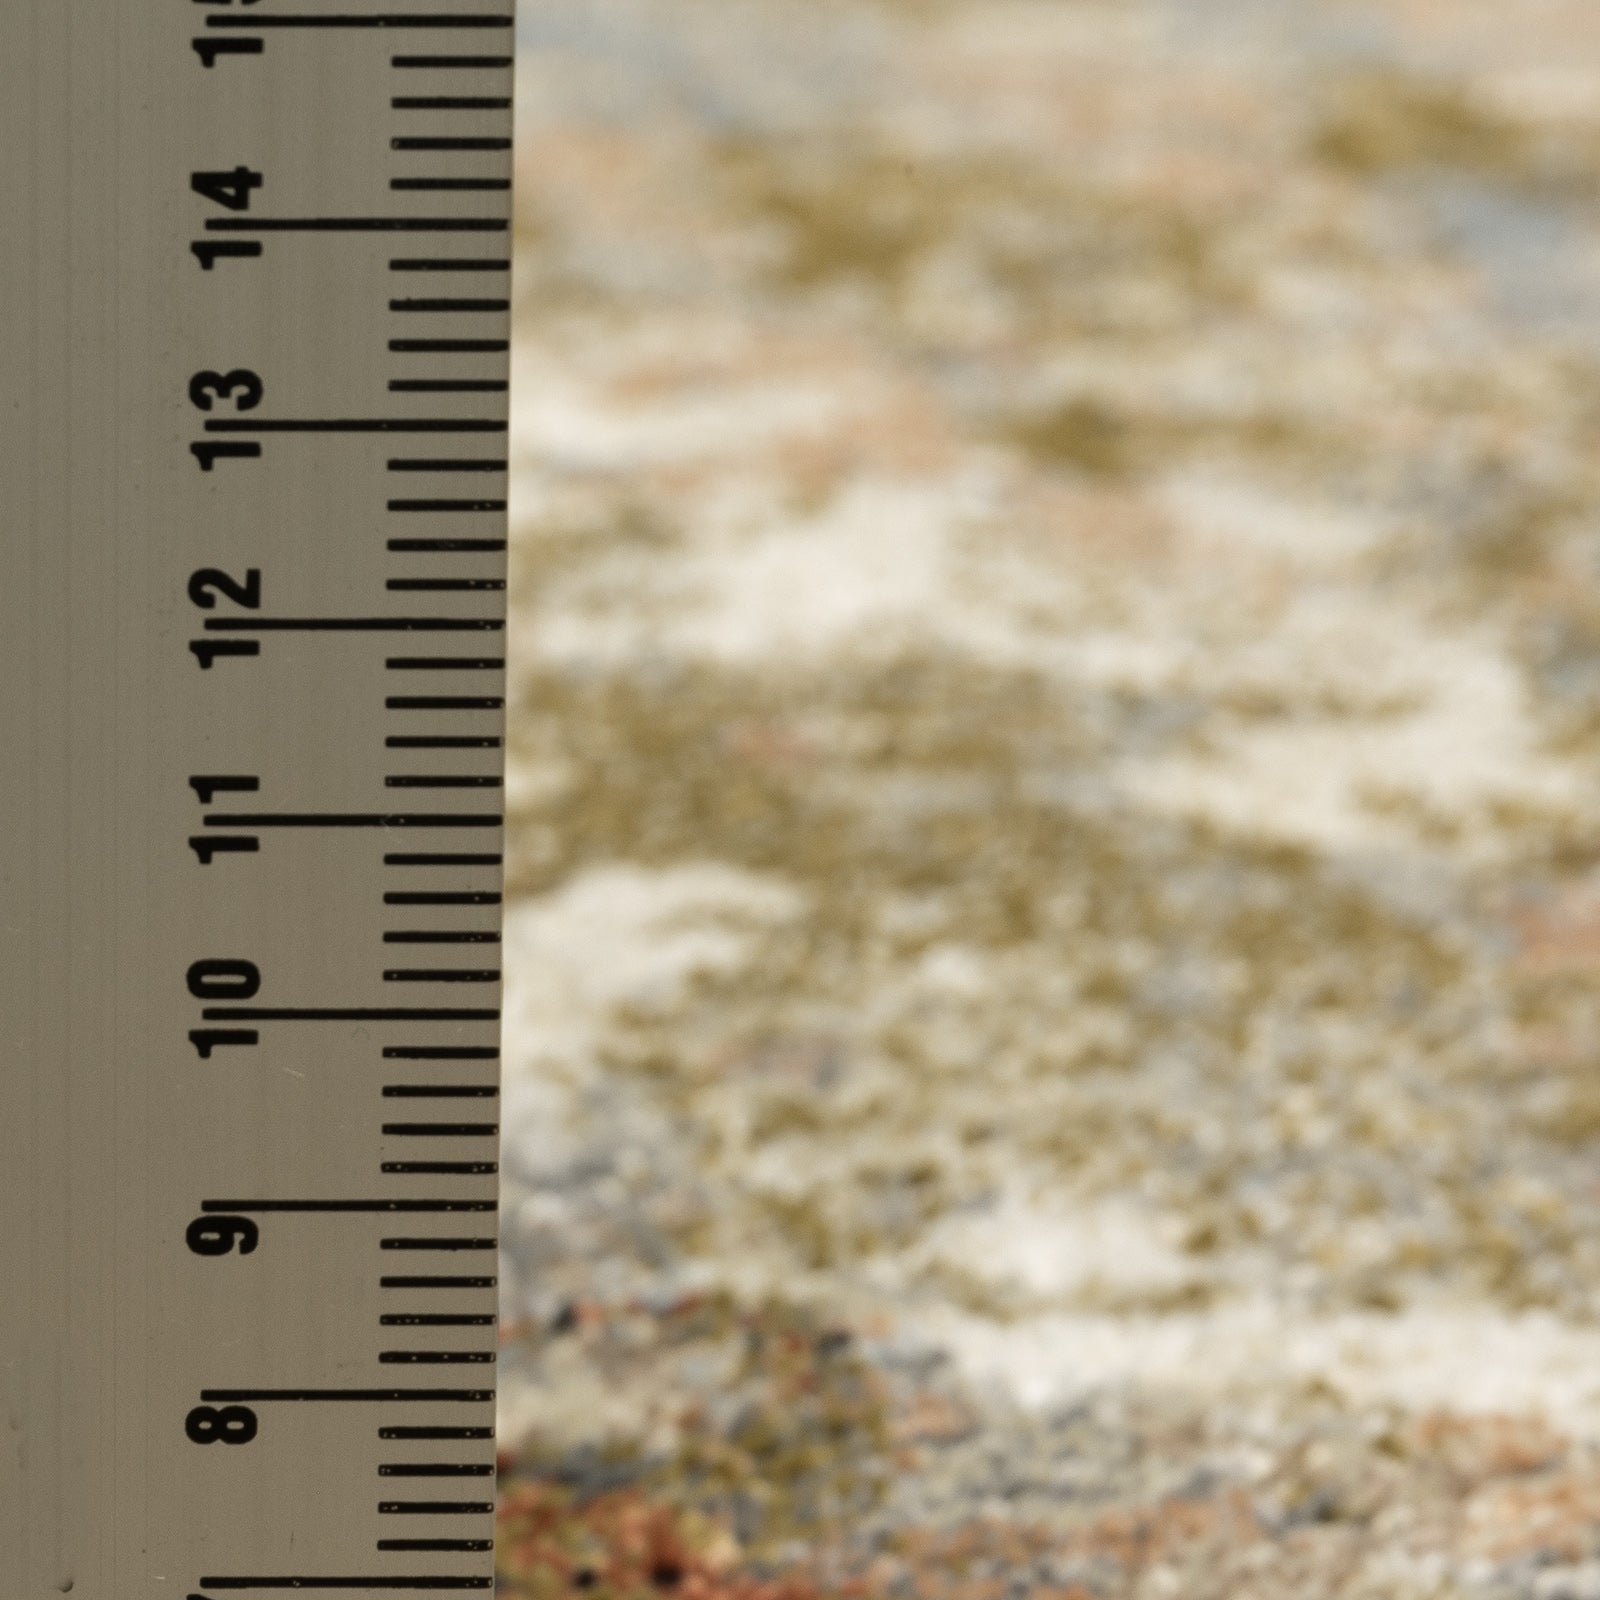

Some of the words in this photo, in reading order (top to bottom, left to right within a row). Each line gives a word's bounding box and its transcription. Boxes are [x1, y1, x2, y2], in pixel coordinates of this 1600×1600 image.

[190, 0, 264, 69] 1
[190, 166, 263, 271] 14
[188, 369, 264, 472] 13
[187, 568, 261, 670] 12
[188, 775, 260, 865] 11
[185, 958, 261, 1059] 10
[185, 1215, 259, 1257] 9
[184, 1405, 258, 1445] 8
